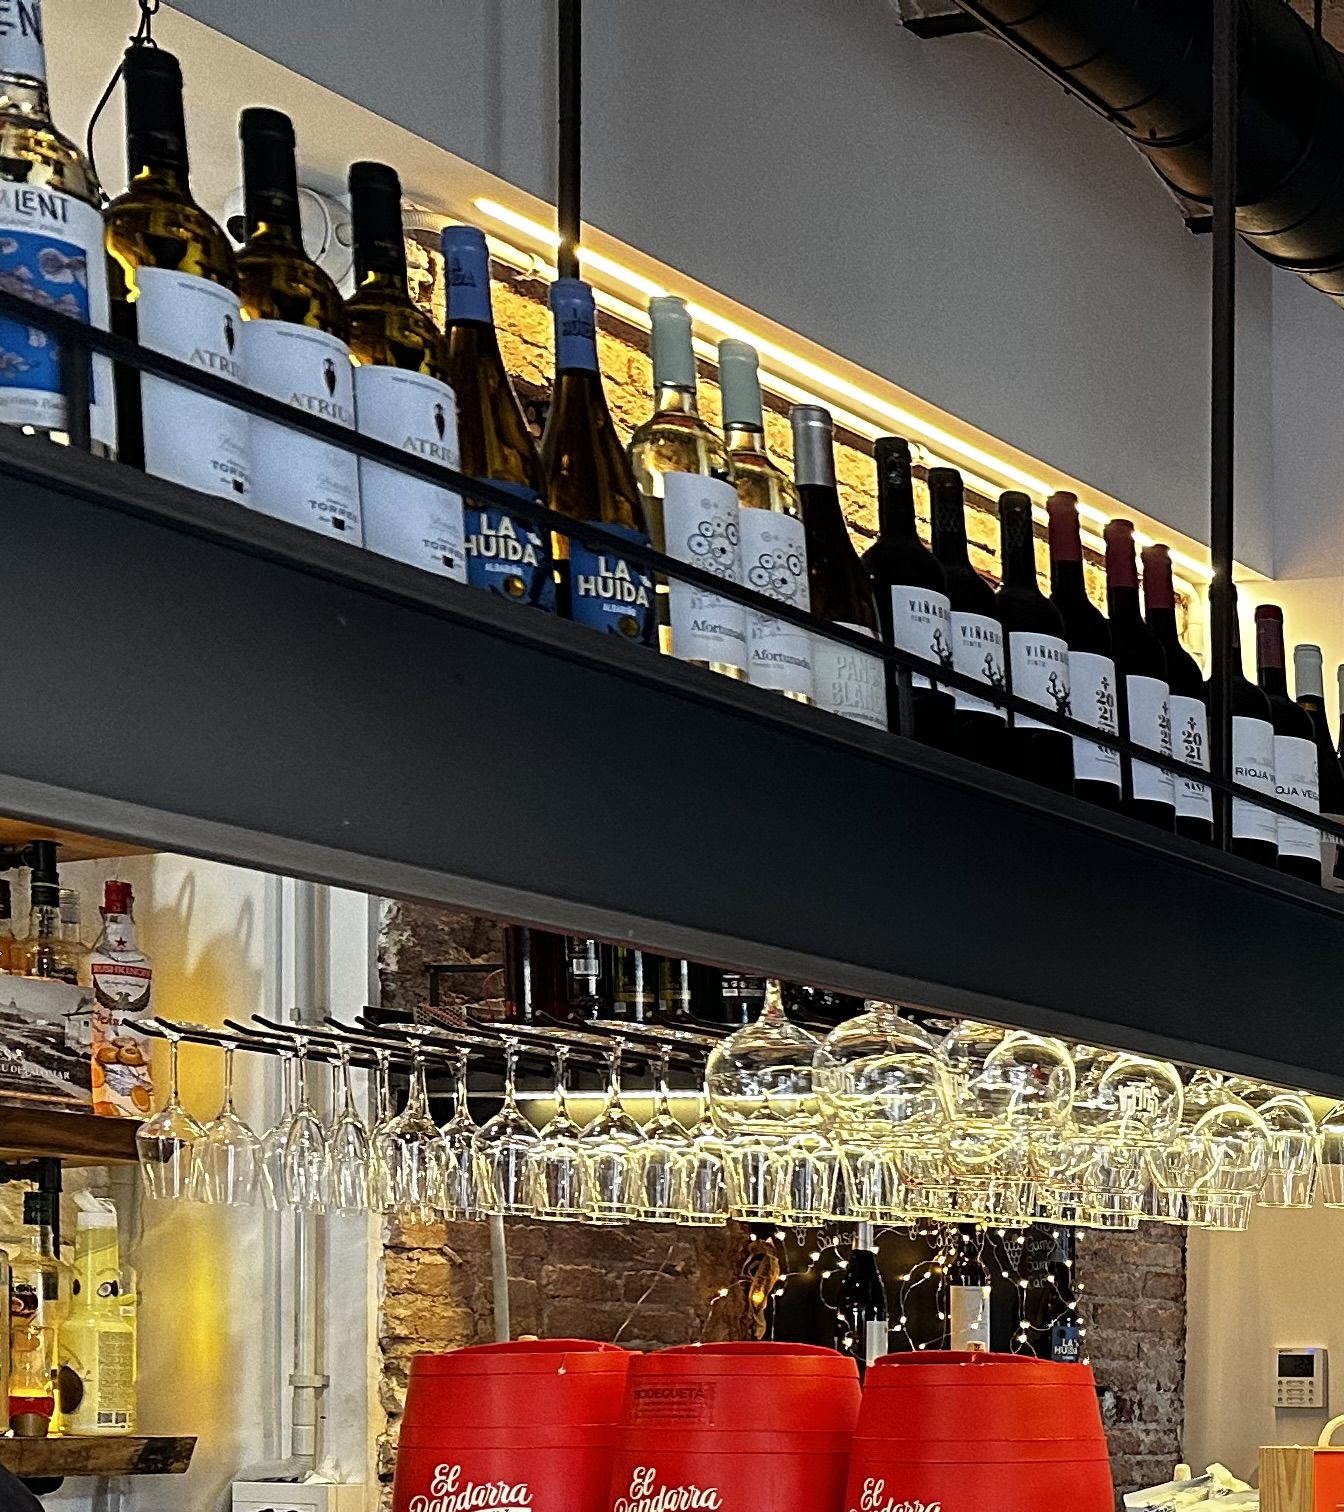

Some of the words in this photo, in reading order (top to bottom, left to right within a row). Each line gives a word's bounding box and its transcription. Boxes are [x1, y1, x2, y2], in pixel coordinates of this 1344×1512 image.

[1, 188, 68, 223] LENT
[189, 349, 241, 378] ATRI
[288, 392, 350, 422] ATRIU
[480, 513, 516, 539] LA
[464, 534, 538, 566] HUIDA
[598, 556, 630, 581] LA
[577, 574, 649, 608] HUIDA
[1235, 766, 1267, 779] RIOJA
[1275, 785, 1298, 796] OJA
[431, 1464, 461, 1497] El
[629, 1466, 656, 1499] El
[860, 1477, 885, 1508] El
